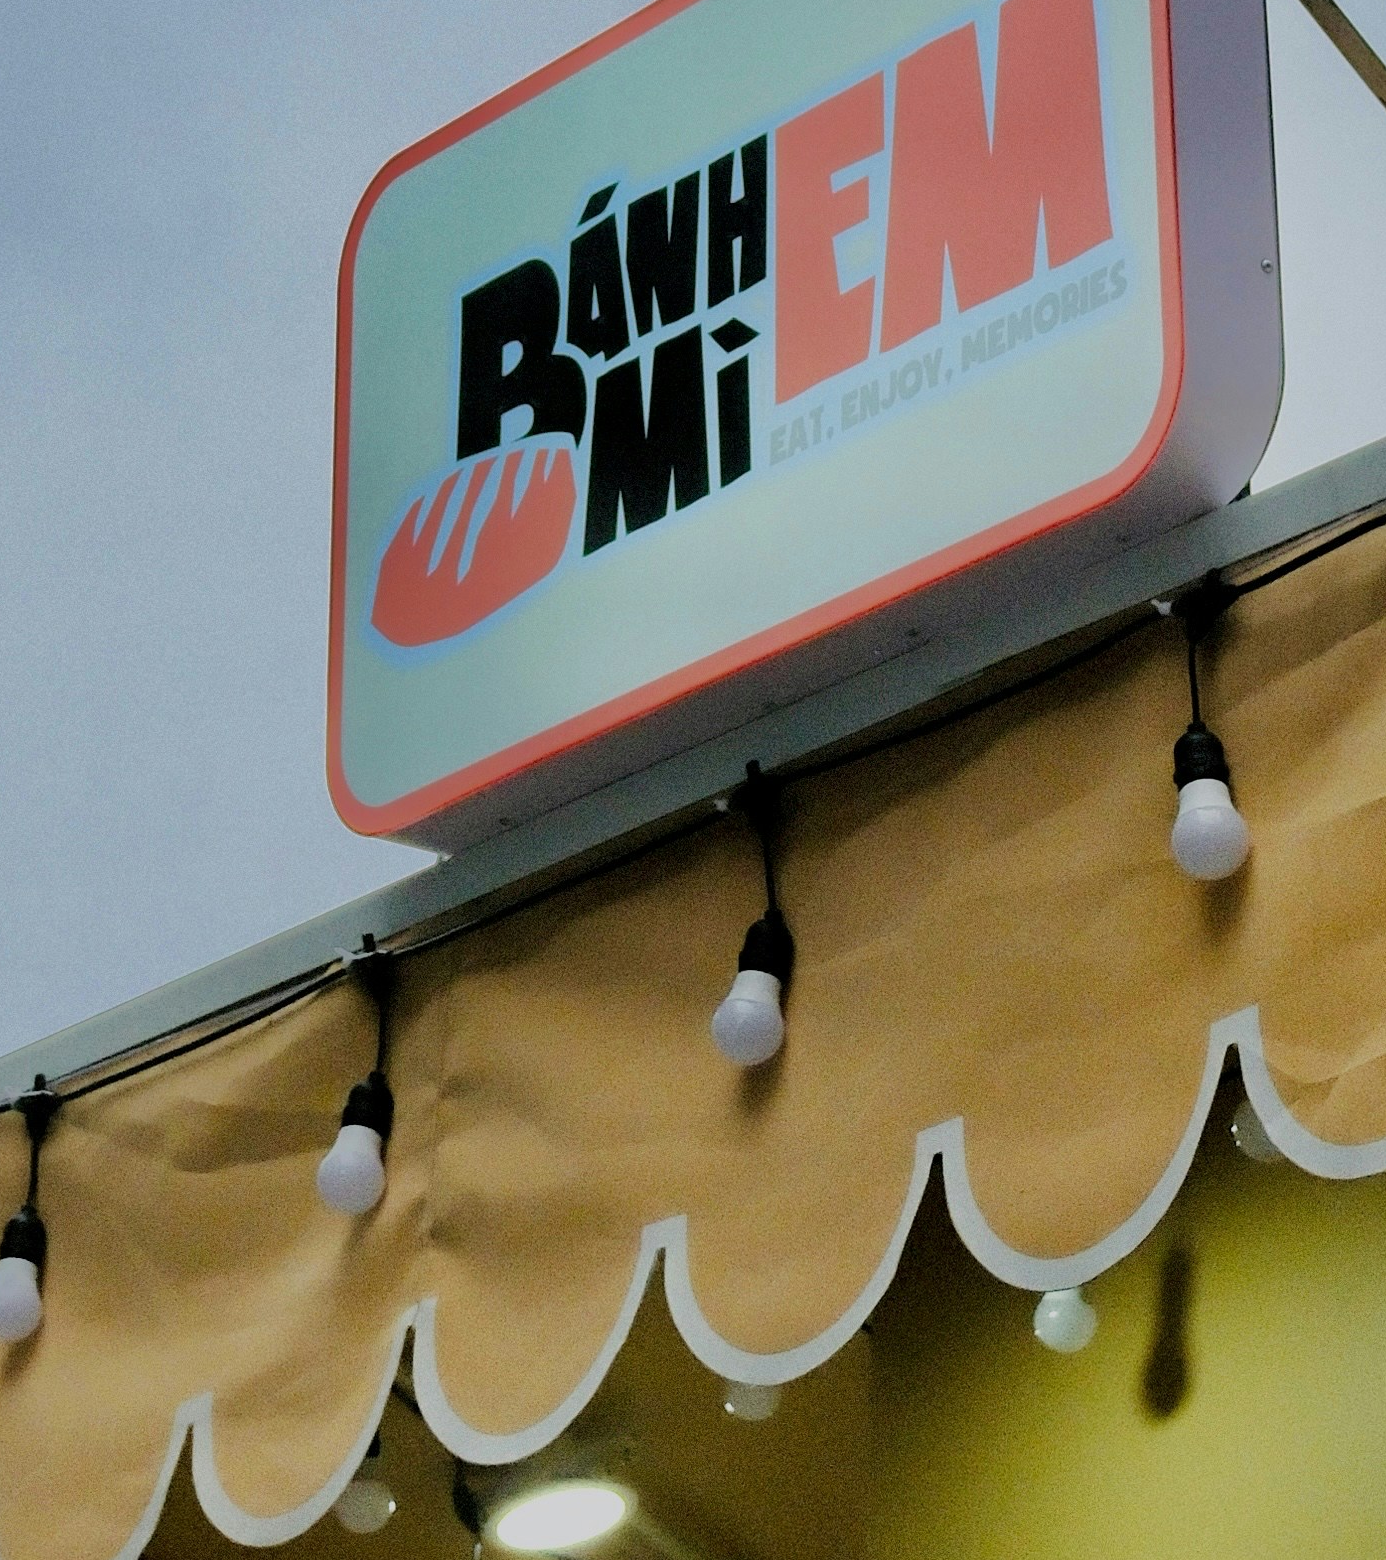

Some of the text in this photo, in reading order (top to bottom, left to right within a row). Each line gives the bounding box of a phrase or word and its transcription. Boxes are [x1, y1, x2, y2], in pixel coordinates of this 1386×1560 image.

[456, 132, 769, 461] BÁNH
[840, 347, 953, 431] ENJOY,
[960, 258, 1128, 372] MEMORIES
[582, 316, 761, 558] MÌ
